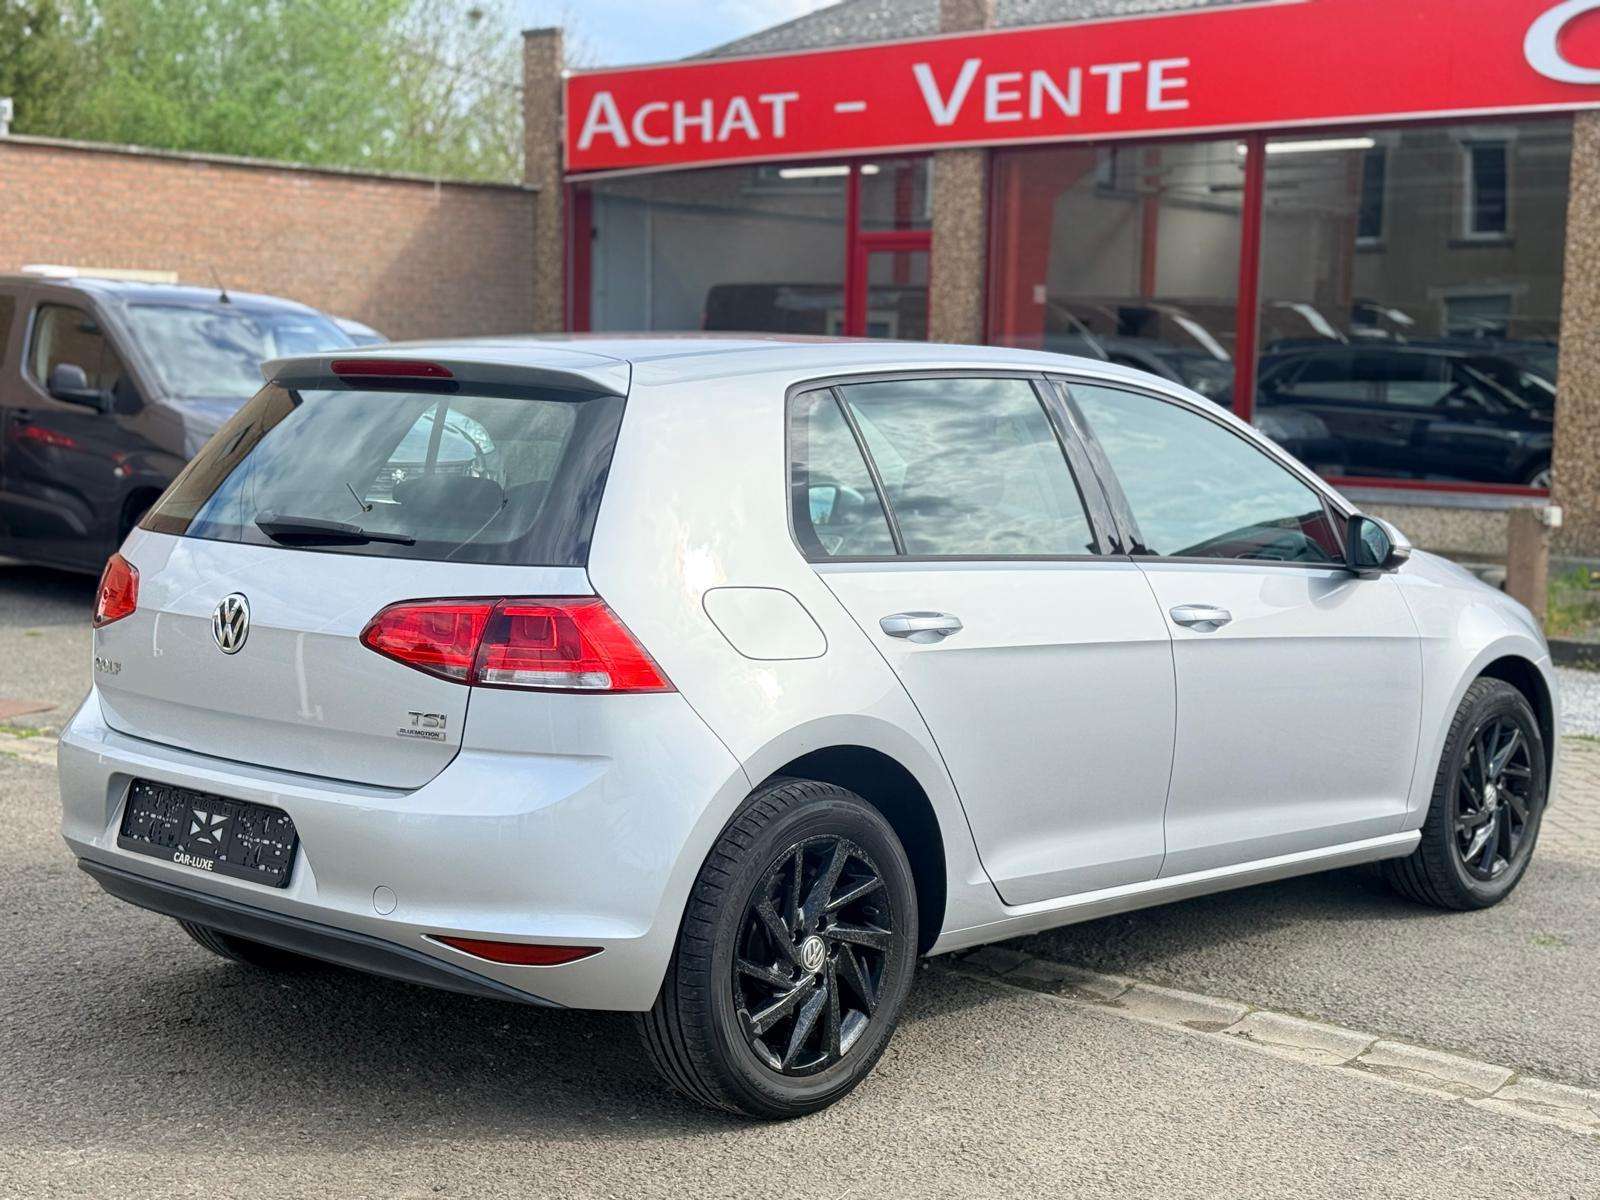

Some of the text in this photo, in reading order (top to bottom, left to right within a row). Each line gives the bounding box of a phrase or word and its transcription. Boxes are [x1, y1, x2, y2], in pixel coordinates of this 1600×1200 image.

[577, 91, 799, 150] ACHAT
[912, 57, 1190, 126] VENTE
[212, 592, 250, 654] VW
[173, 851, 214, 871] CAR-LUXE
[801, 936, 826, 972] VW
